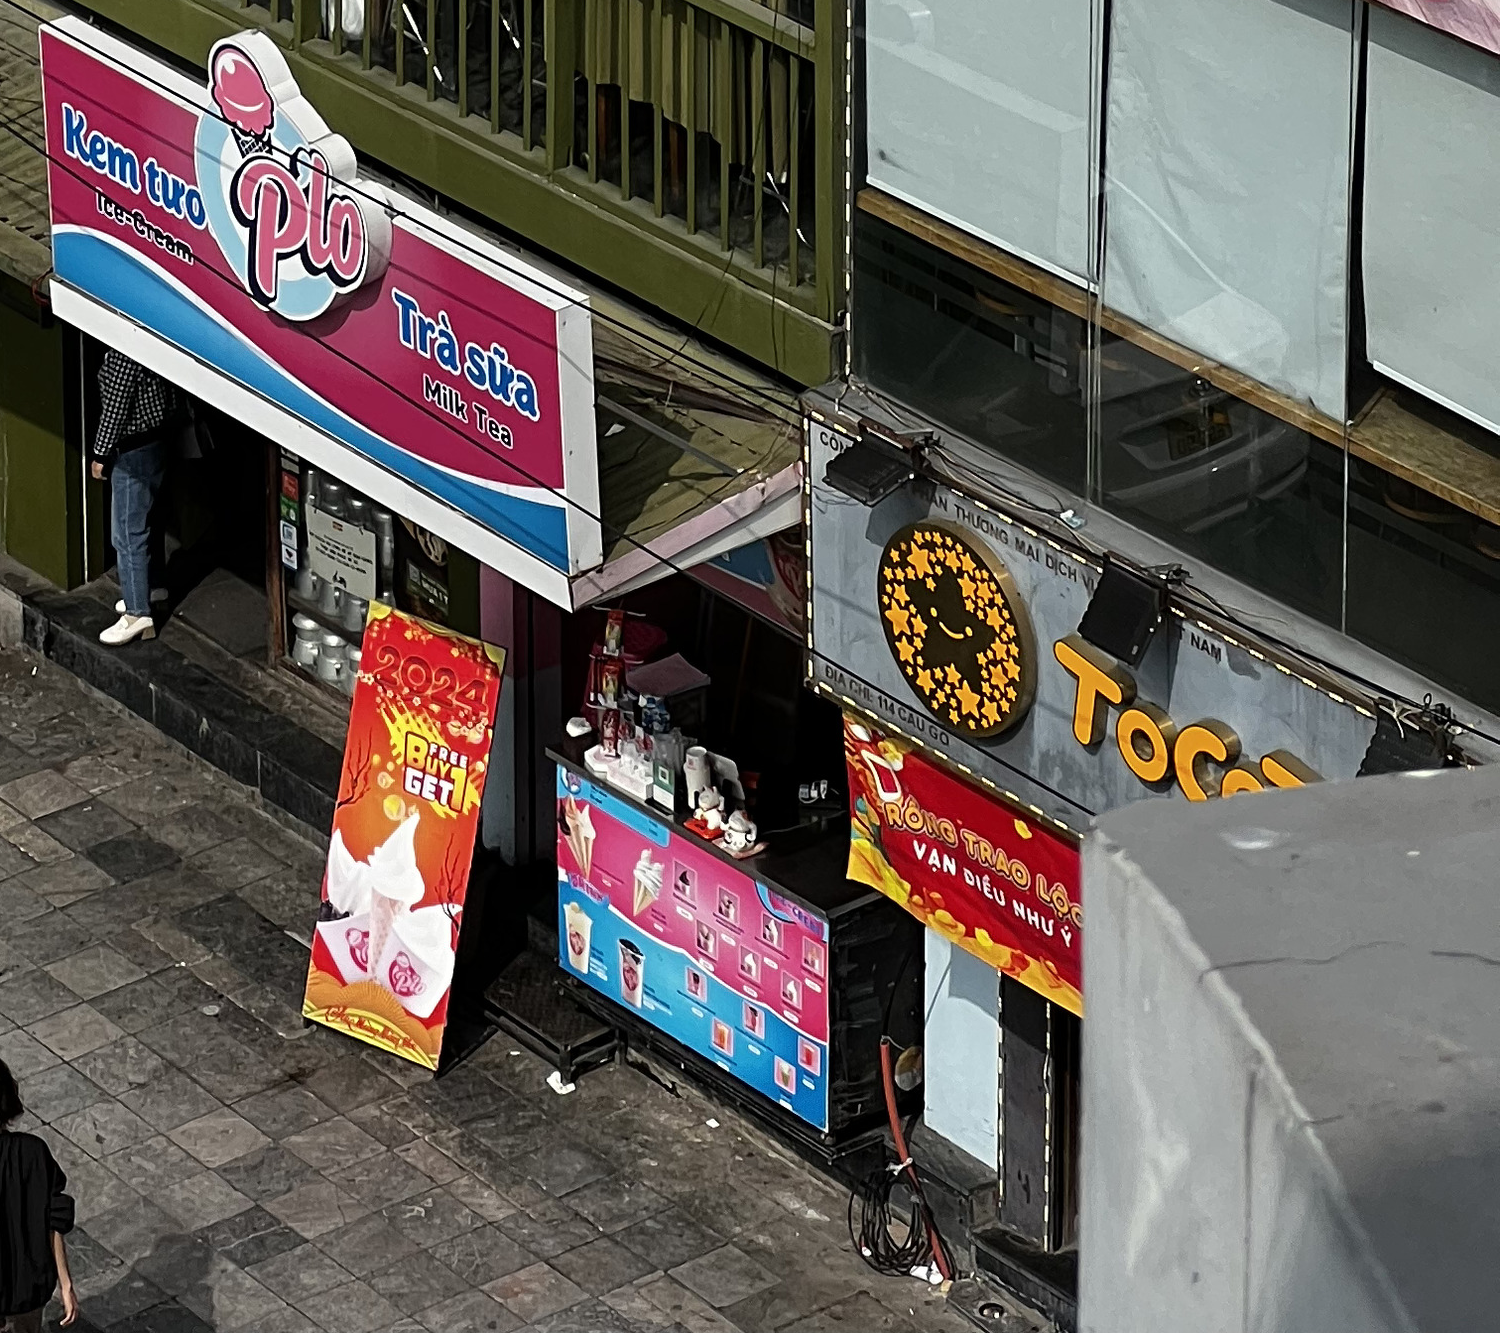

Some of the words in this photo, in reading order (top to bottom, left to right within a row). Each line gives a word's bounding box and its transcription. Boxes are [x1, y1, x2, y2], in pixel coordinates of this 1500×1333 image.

[63, 104, 140, 193] Kem
[97, 189, 193, 263] Ice-Cream
[392, 288, 460, 375] Trà
[465, 343, 540, 421] sữa
[424, 375, 468, 422] Milk
[473, 403, 513, 449] Tea
[953, 501, 1009, 545] THƯƠNG
[1190, 633, 1222, 662] NAM
[373, 646, 488, 719] 2024
[878, 695, 895, 715] 114
[405, 767, 453, 806] GET
[451, 767, 467, 813] 1
[406, 732, 451, 780] BUY
[430, 744, 468, 768] FREE
[913, 840, 956, 876] VẠN
[1013, 899, 1054, 936] NHƯ
[961, 829, 1030, 889] TRAO
